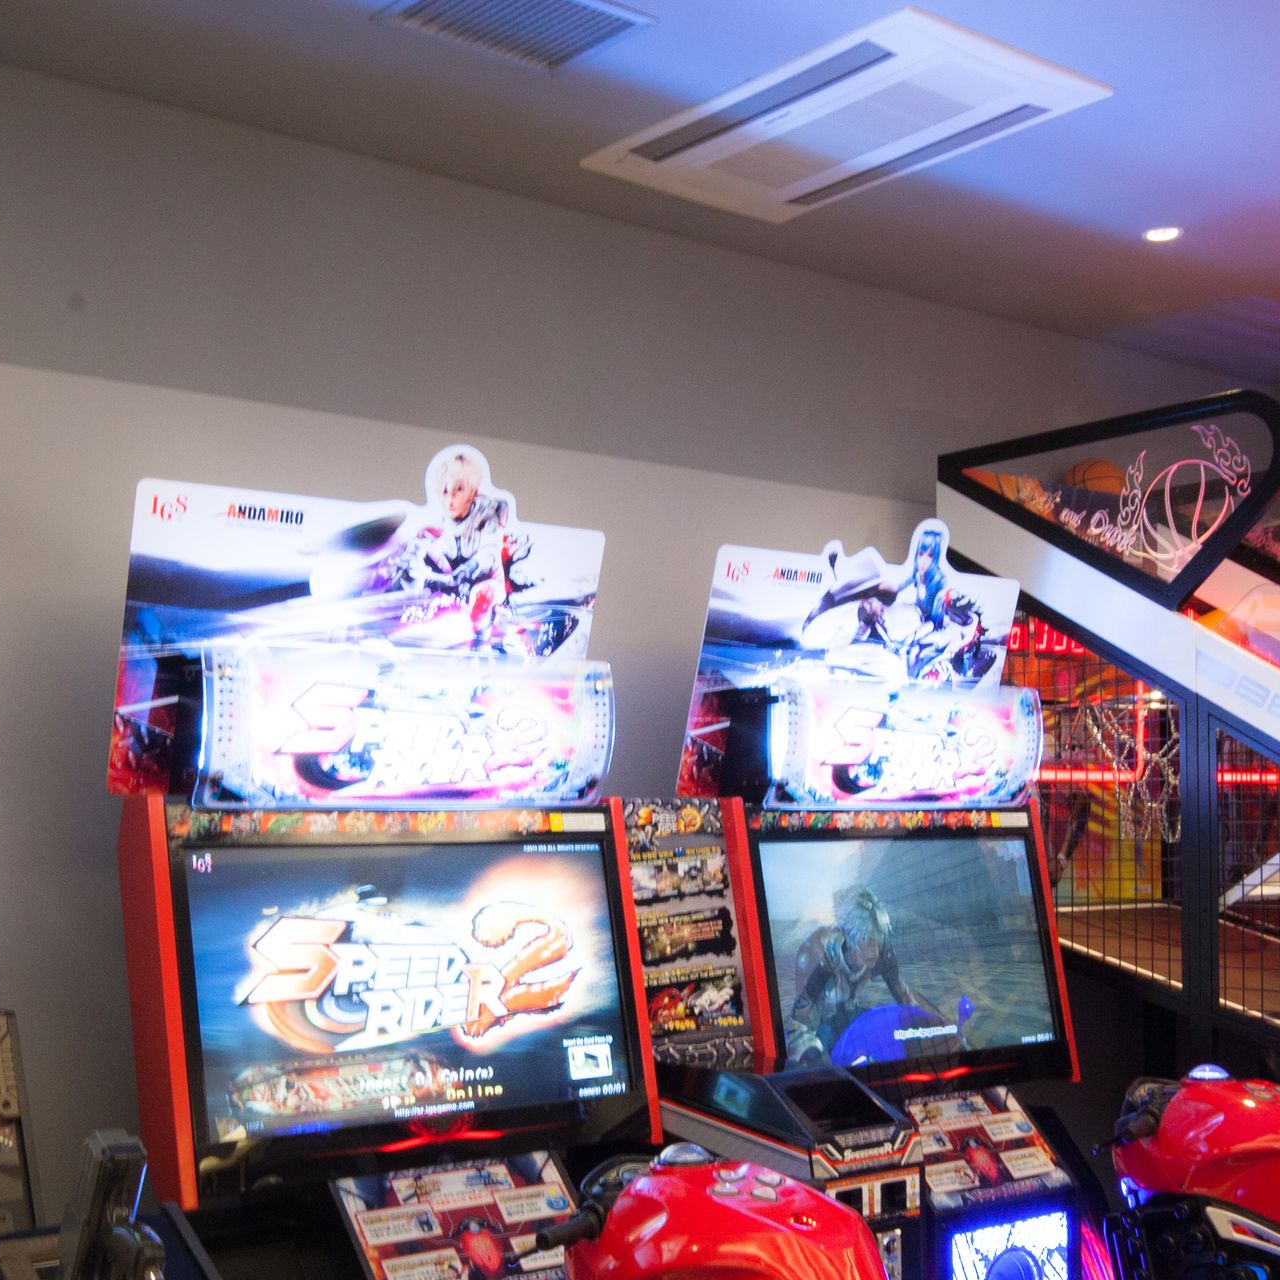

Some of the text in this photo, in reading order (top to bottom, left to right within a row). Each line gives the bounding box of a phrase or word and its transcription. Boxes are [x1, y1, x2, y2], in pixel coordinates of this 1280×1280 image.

[151, 494, 188, 521] IGS
[227, 502, 304, 526] ANDAMIRO
[726, 560, 751, 582] IGS
[773, 567, 823, 584] ANDAMIRO
[234, 915, 470, 1006] SPEED
[352, 900, 583, 1043] RIDER 2
